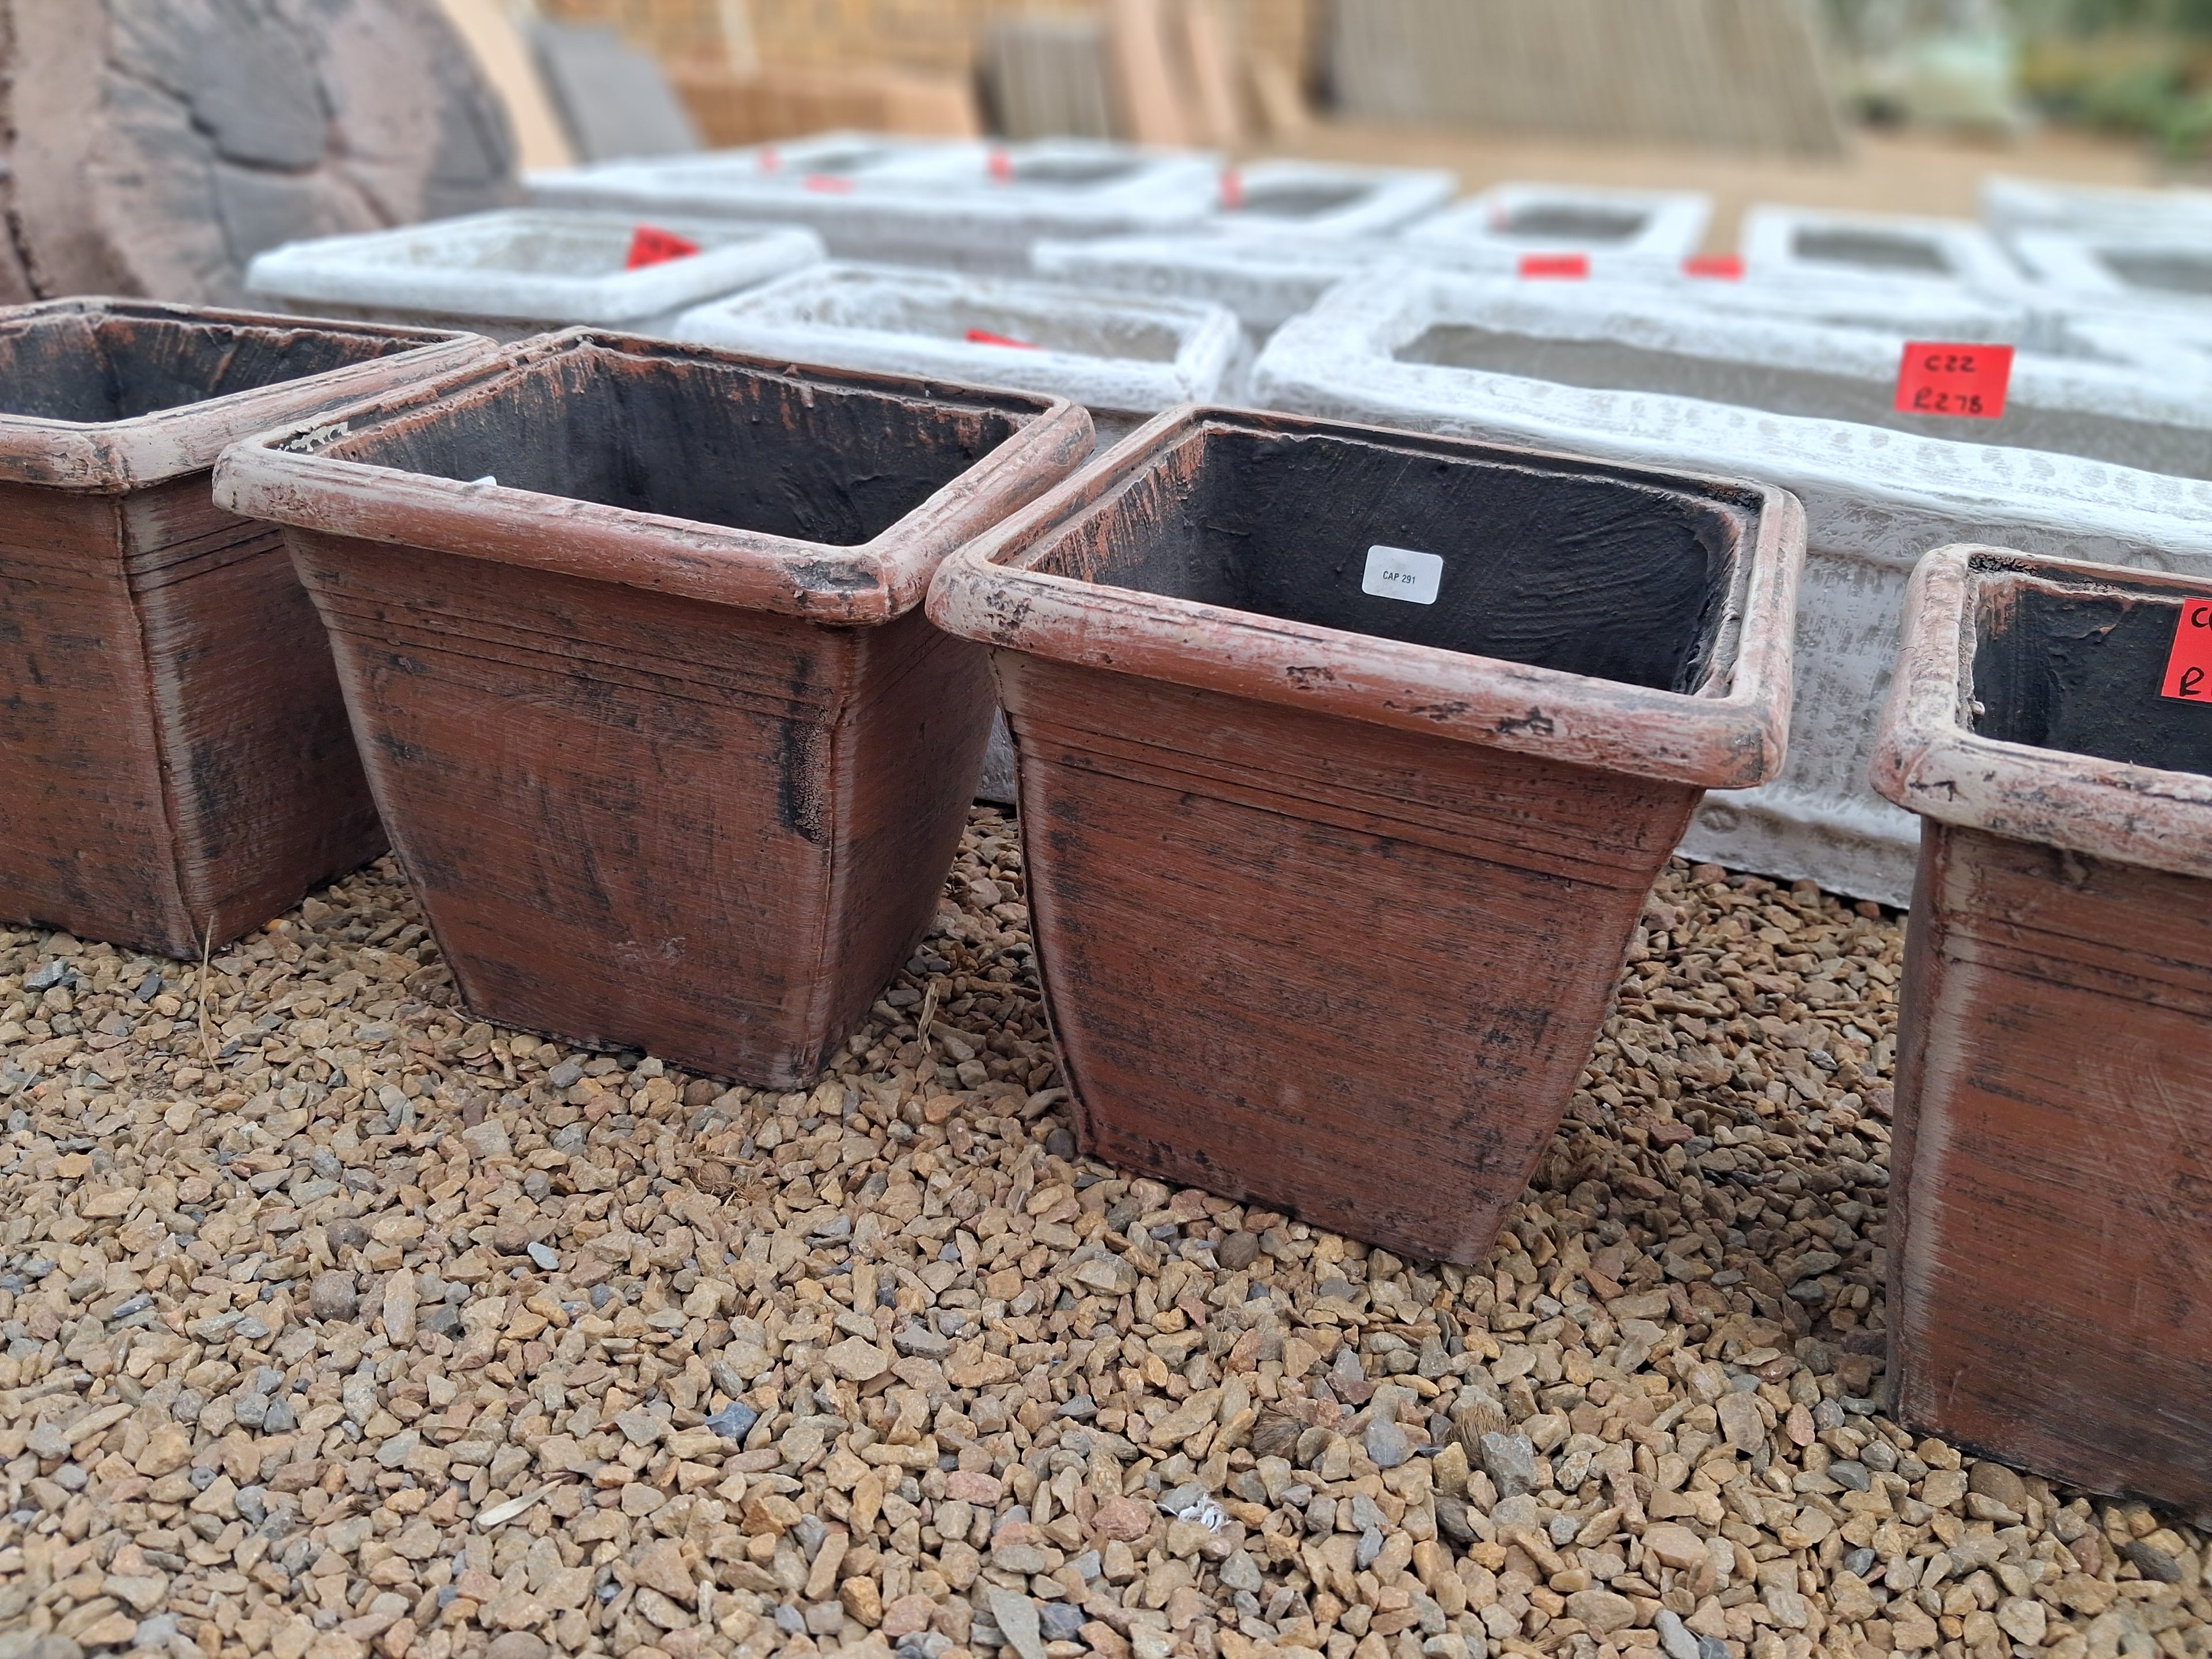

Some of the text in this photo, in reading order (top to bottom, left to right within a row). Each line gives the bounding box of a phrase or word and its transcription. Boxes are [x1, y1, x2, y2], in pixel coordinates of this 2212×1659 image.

[1923, 354, 1976, 373] C22
[1382, 570, 1415, 585] CAP 291
[2191, 607, 2212, 631] C
[2179, 666, 2212, 697] R
